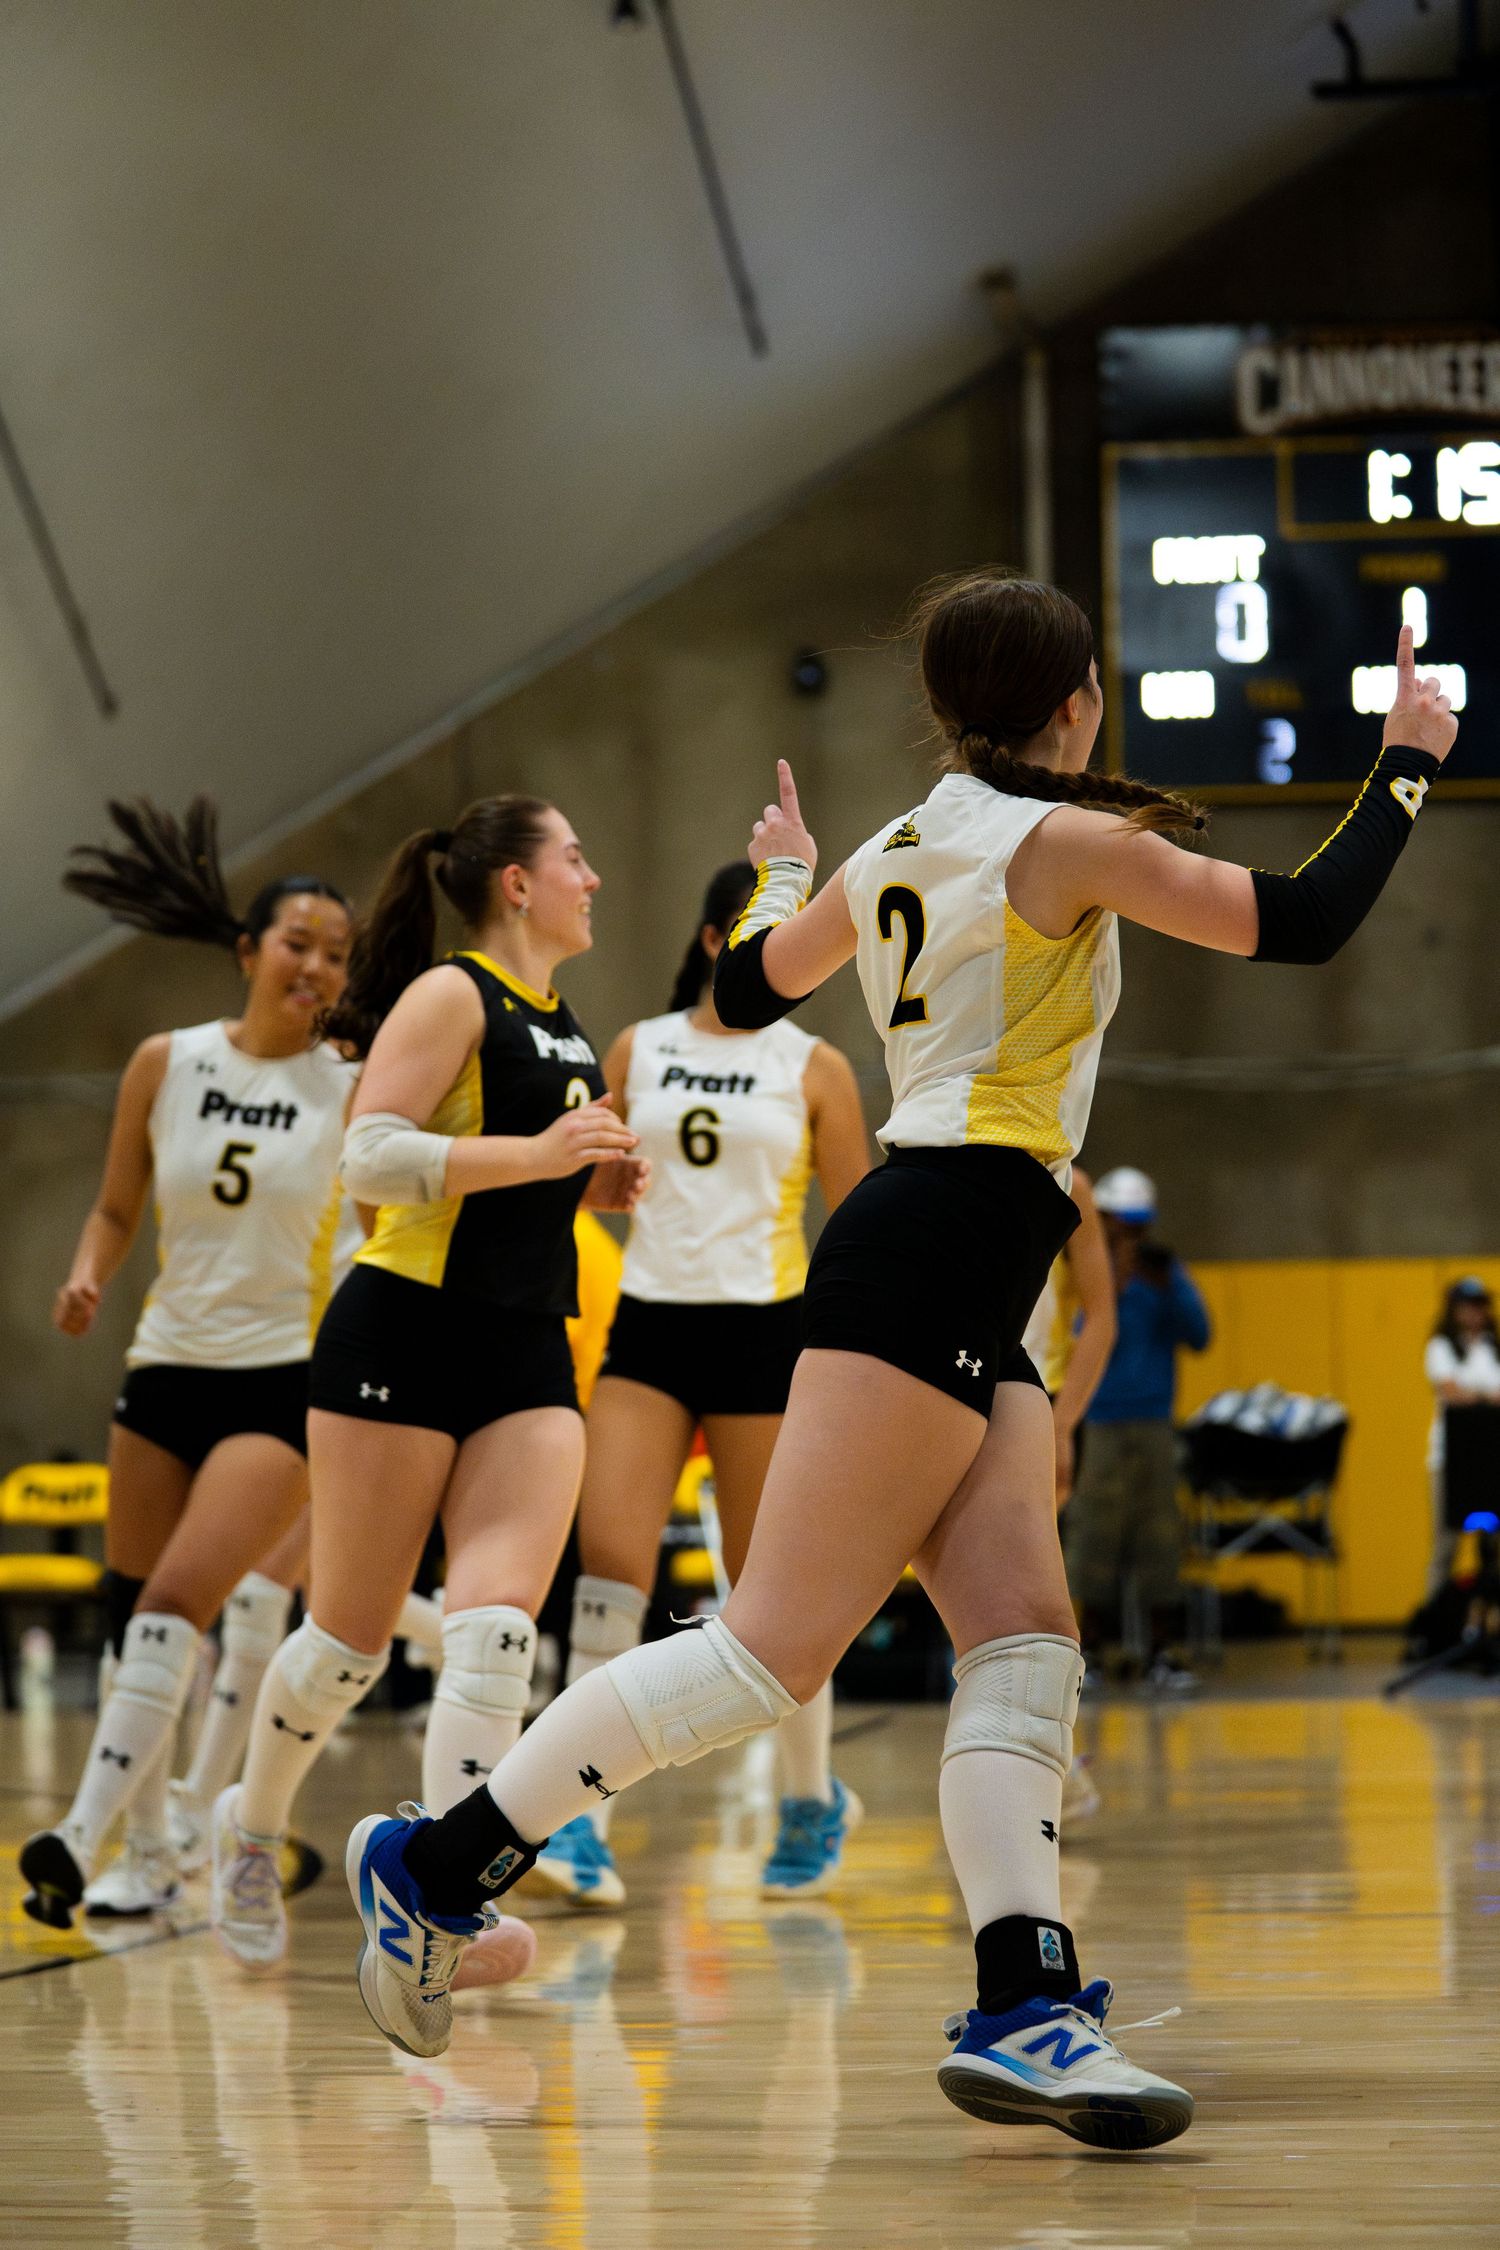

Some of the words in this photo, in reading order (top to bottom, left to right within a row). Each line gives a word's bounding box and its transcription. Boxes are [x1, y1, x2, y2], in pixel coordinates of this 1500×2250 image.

[1215, 581, 1270, 664] 0
[877, 881, 931, 1032] 2
[199, 1087, 299, 1131] Pratt
[660, 1064, 756, 1095] Pratt
[677, 1105, 721, 1169] 6
[211, 1140, 257, 1208] 5
